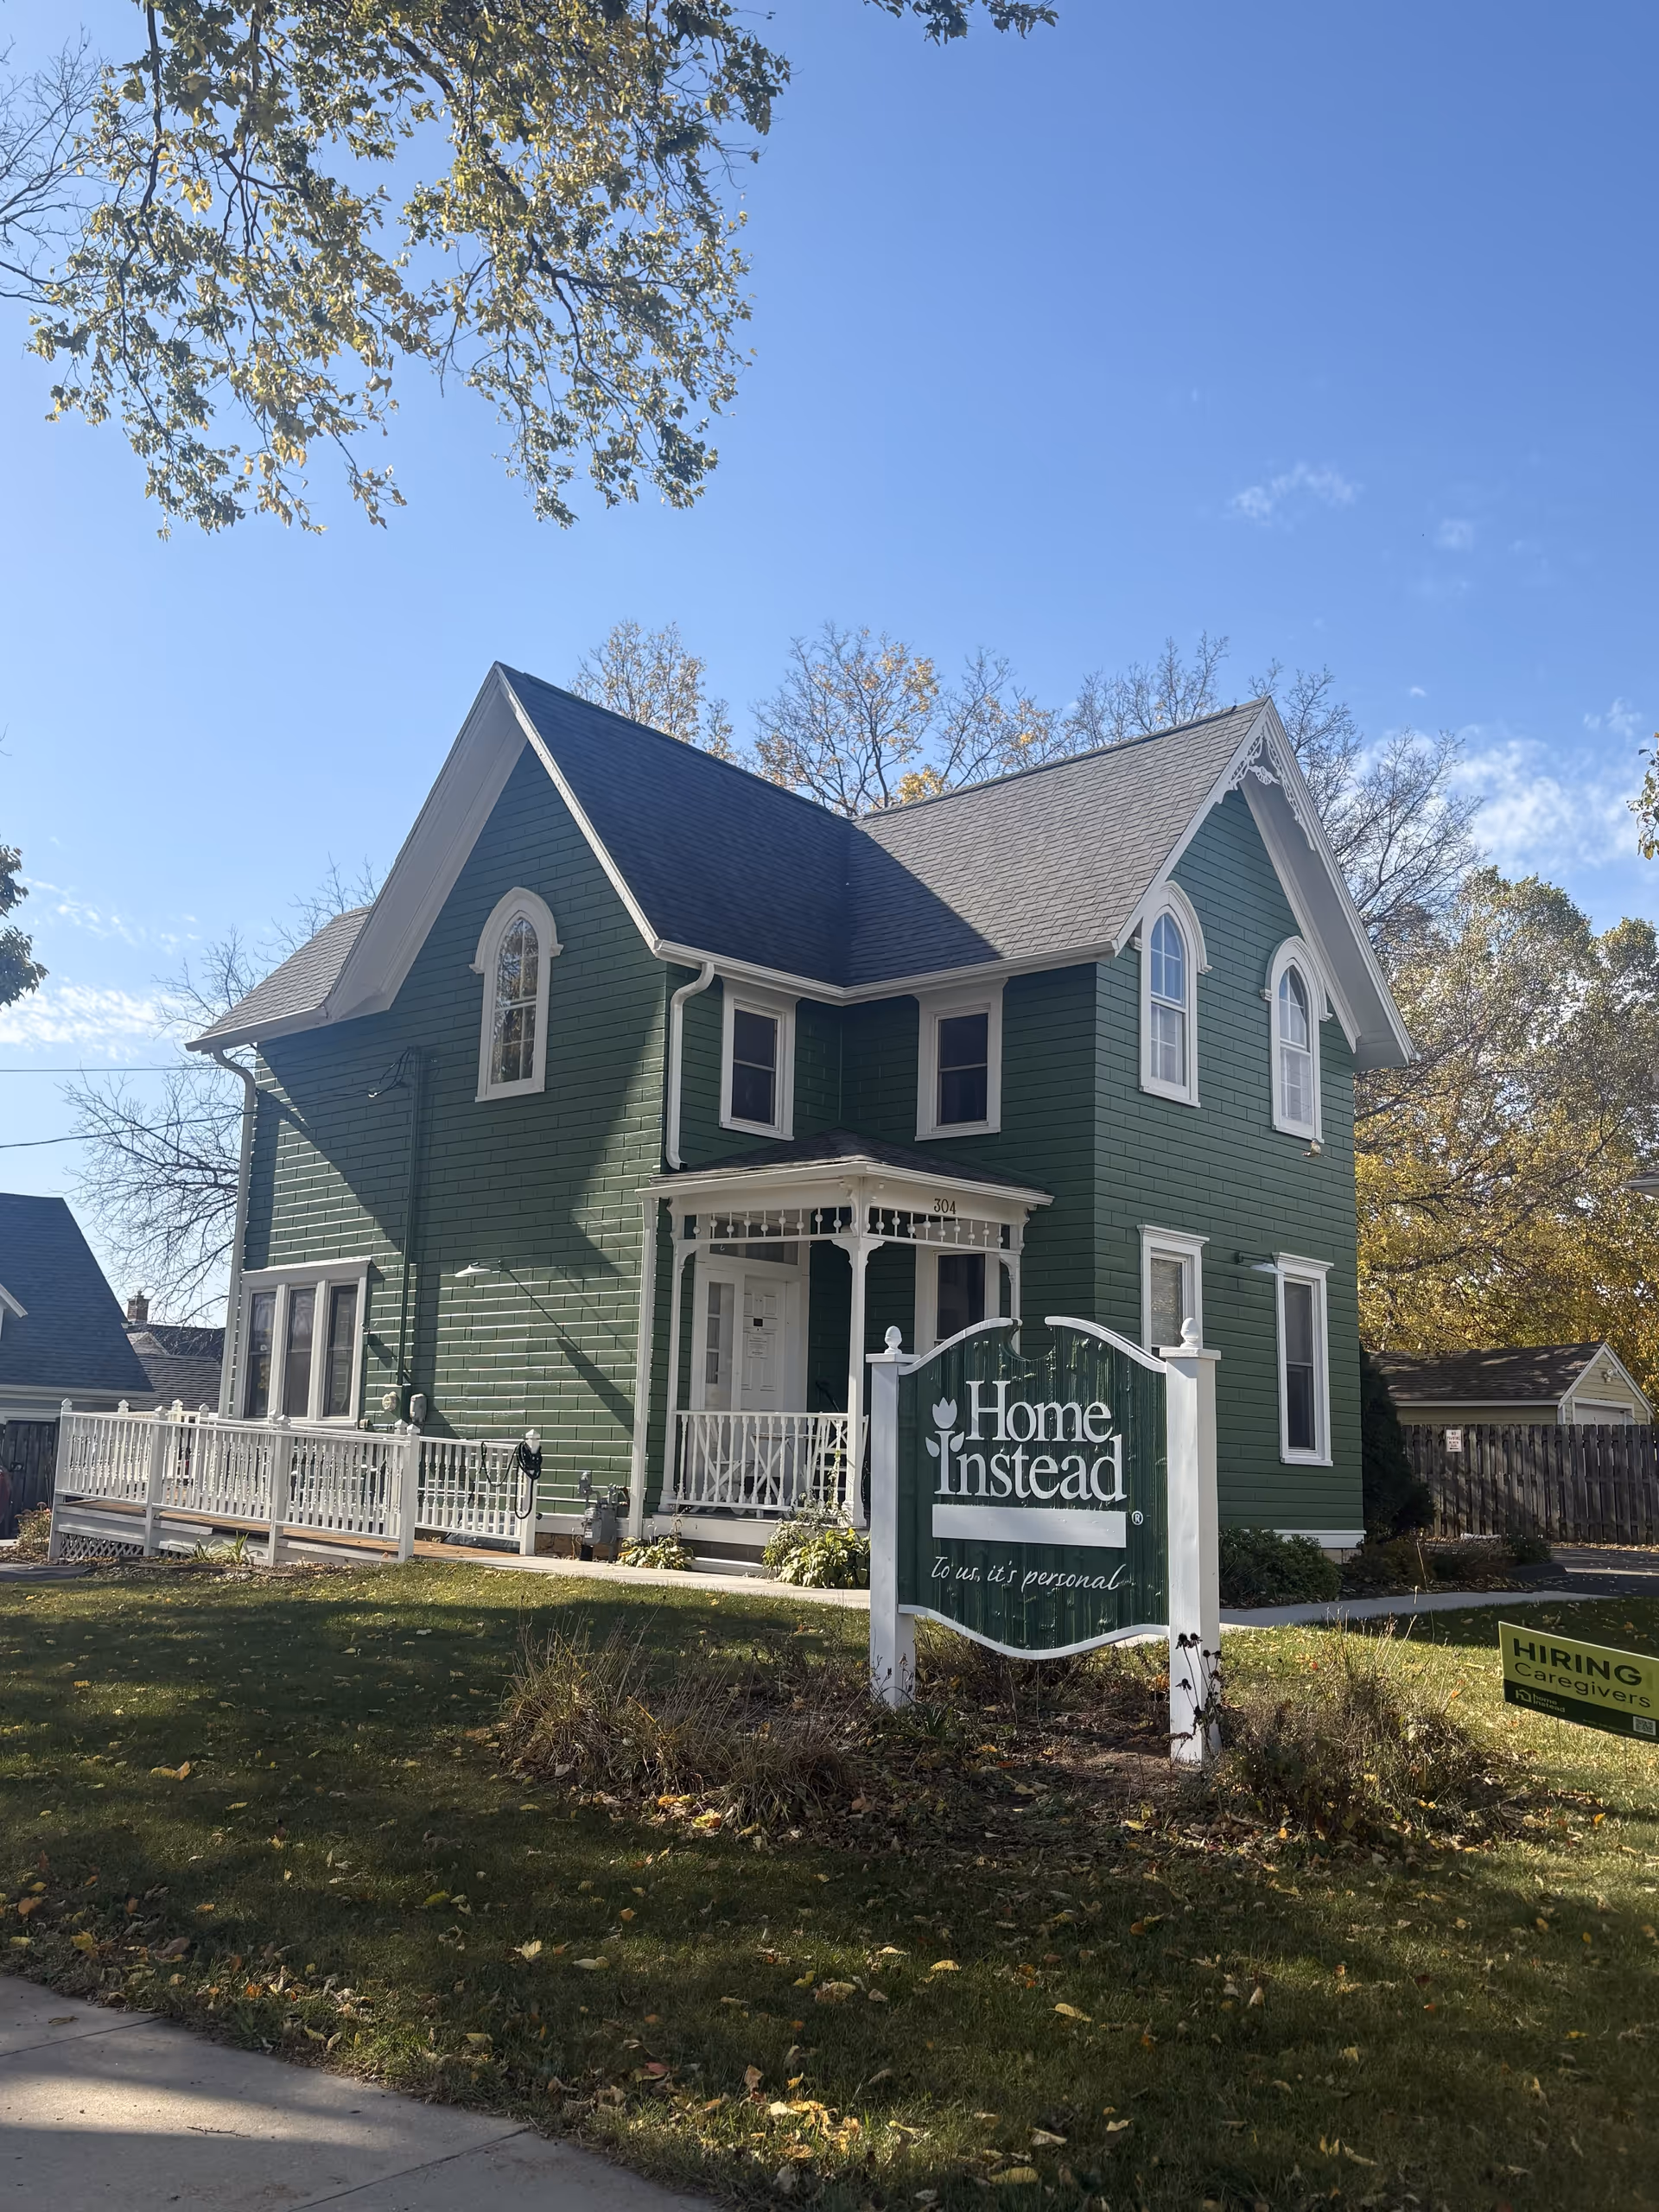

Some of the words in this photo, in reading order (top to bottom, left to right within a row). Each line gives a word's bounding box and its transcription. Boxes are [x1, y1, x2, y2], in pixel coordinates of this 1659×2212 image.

[933, 1198, 957, 1215] 304
[965, 1380, 1113, 1443] Home
[934, 1431, 1127, 1502] Instead
[931, 1556, 950, 1580] To
[987, 1560, 1018, 1584] it's
[1020, 1563, 1127, 1593] personal
[1513, 1637, 1643, 1686] HIRING
[1514, 1662, 1651, 1708] Caregivers
[1533, 1693, 1558, 1706] home
